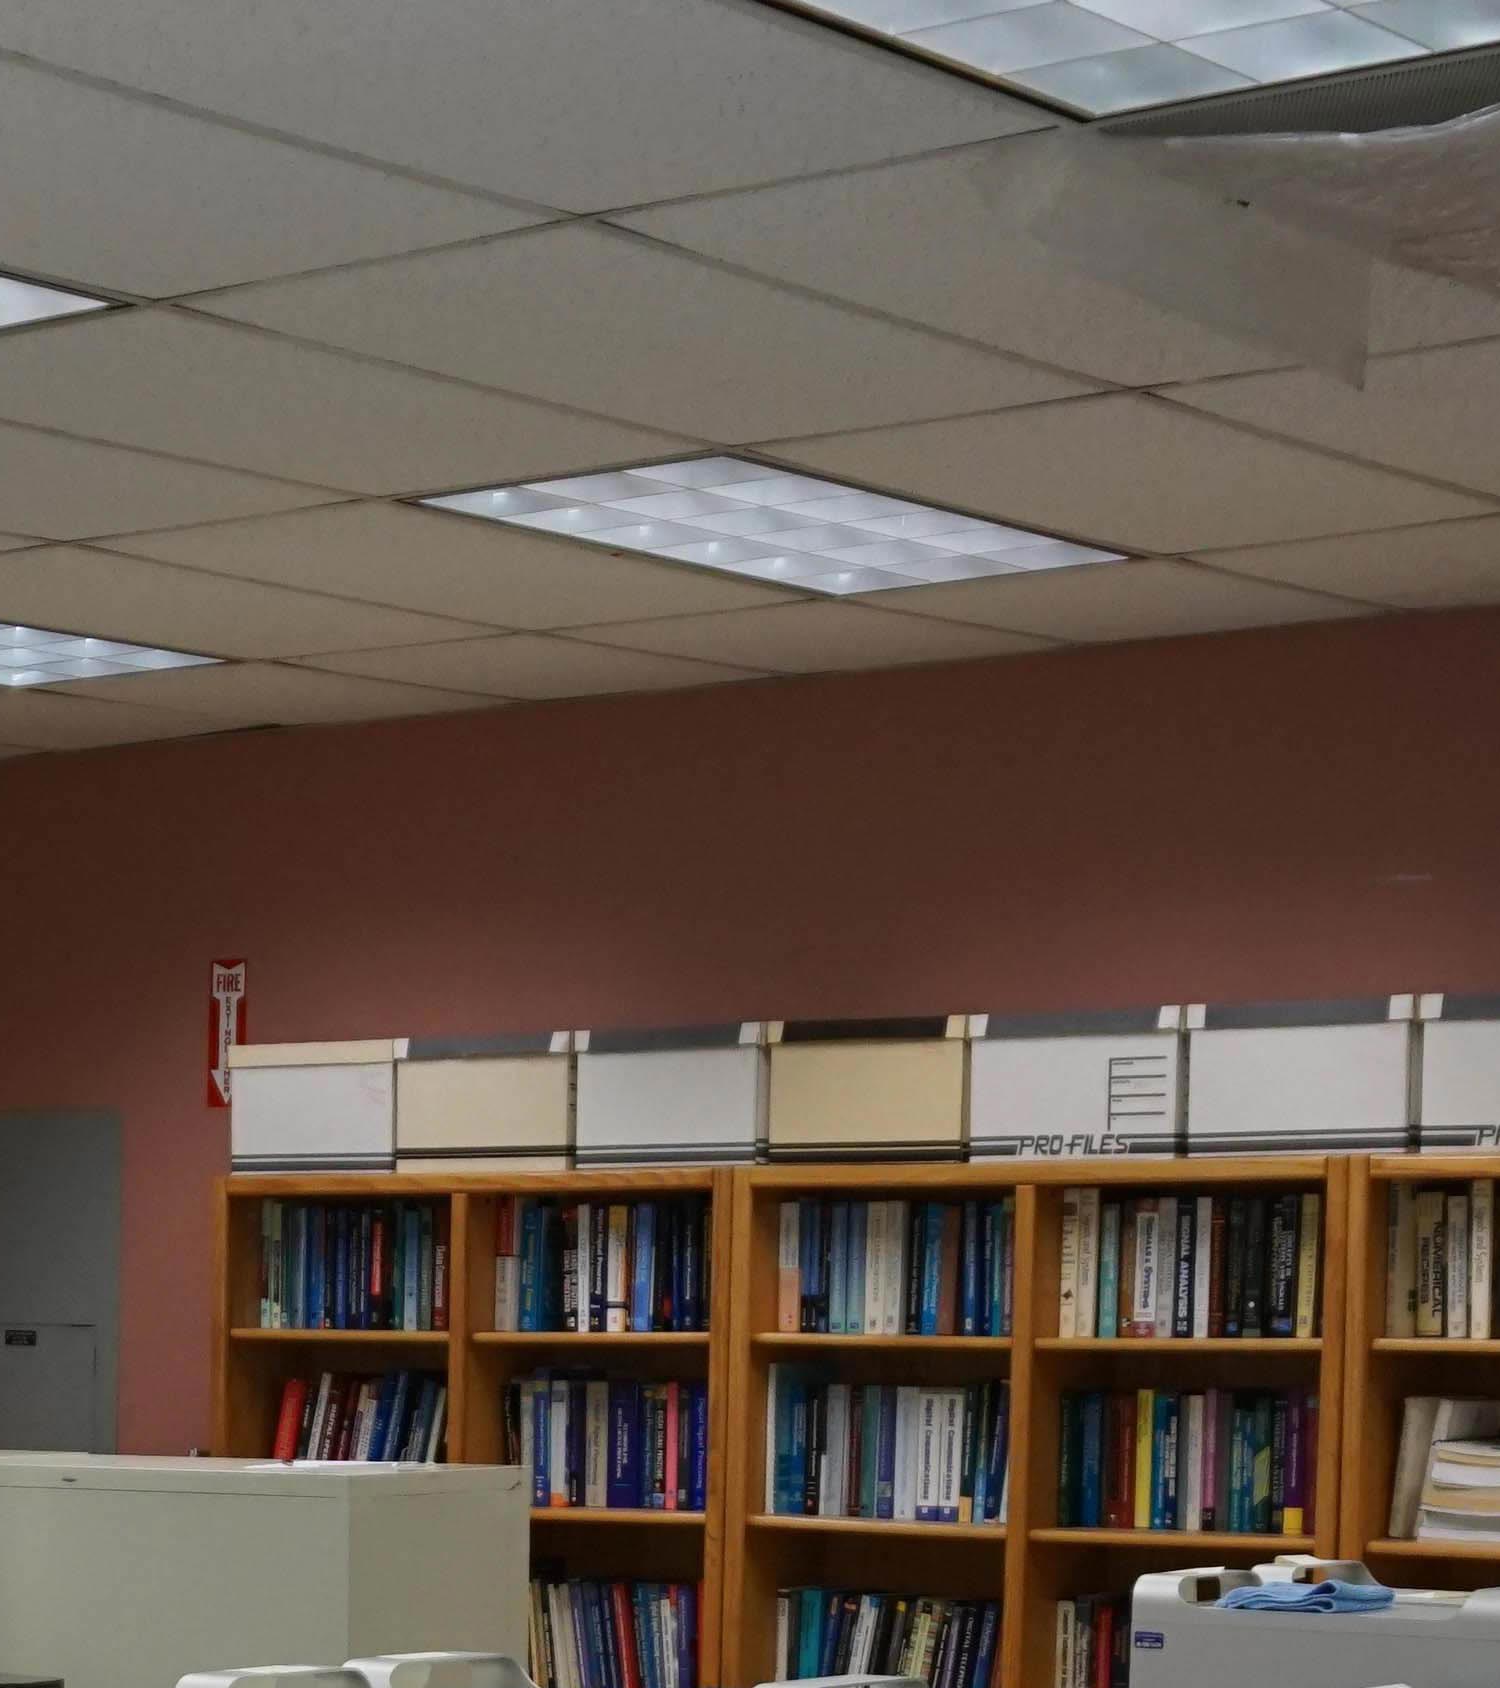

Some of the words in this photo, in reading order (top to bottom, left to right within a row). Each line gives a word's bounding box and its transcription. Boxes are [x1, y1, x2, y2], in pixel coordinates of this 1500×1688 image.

[216, 973, 241, 993] FIRE
[223, 996, 233, 1093] EXTINGHER
[1018, 1134, 1128, 1155] PRO-FILES
[1180, 1216, 1191, 1259] SIGNAL
[594, 1257, 603, 1295] Processing
[1419, 1237, 1430, 1304] RECIPES
[1431, 1221, 1443, 1316] NUMERICAL
[1177, 1261, 1190, 1318] ANALYSIS
[925, 1399, 934, 1426] Digital
[948, 1399, 956, 1427] Digital
[962, 1617, 975, 1648] DIGITAL
